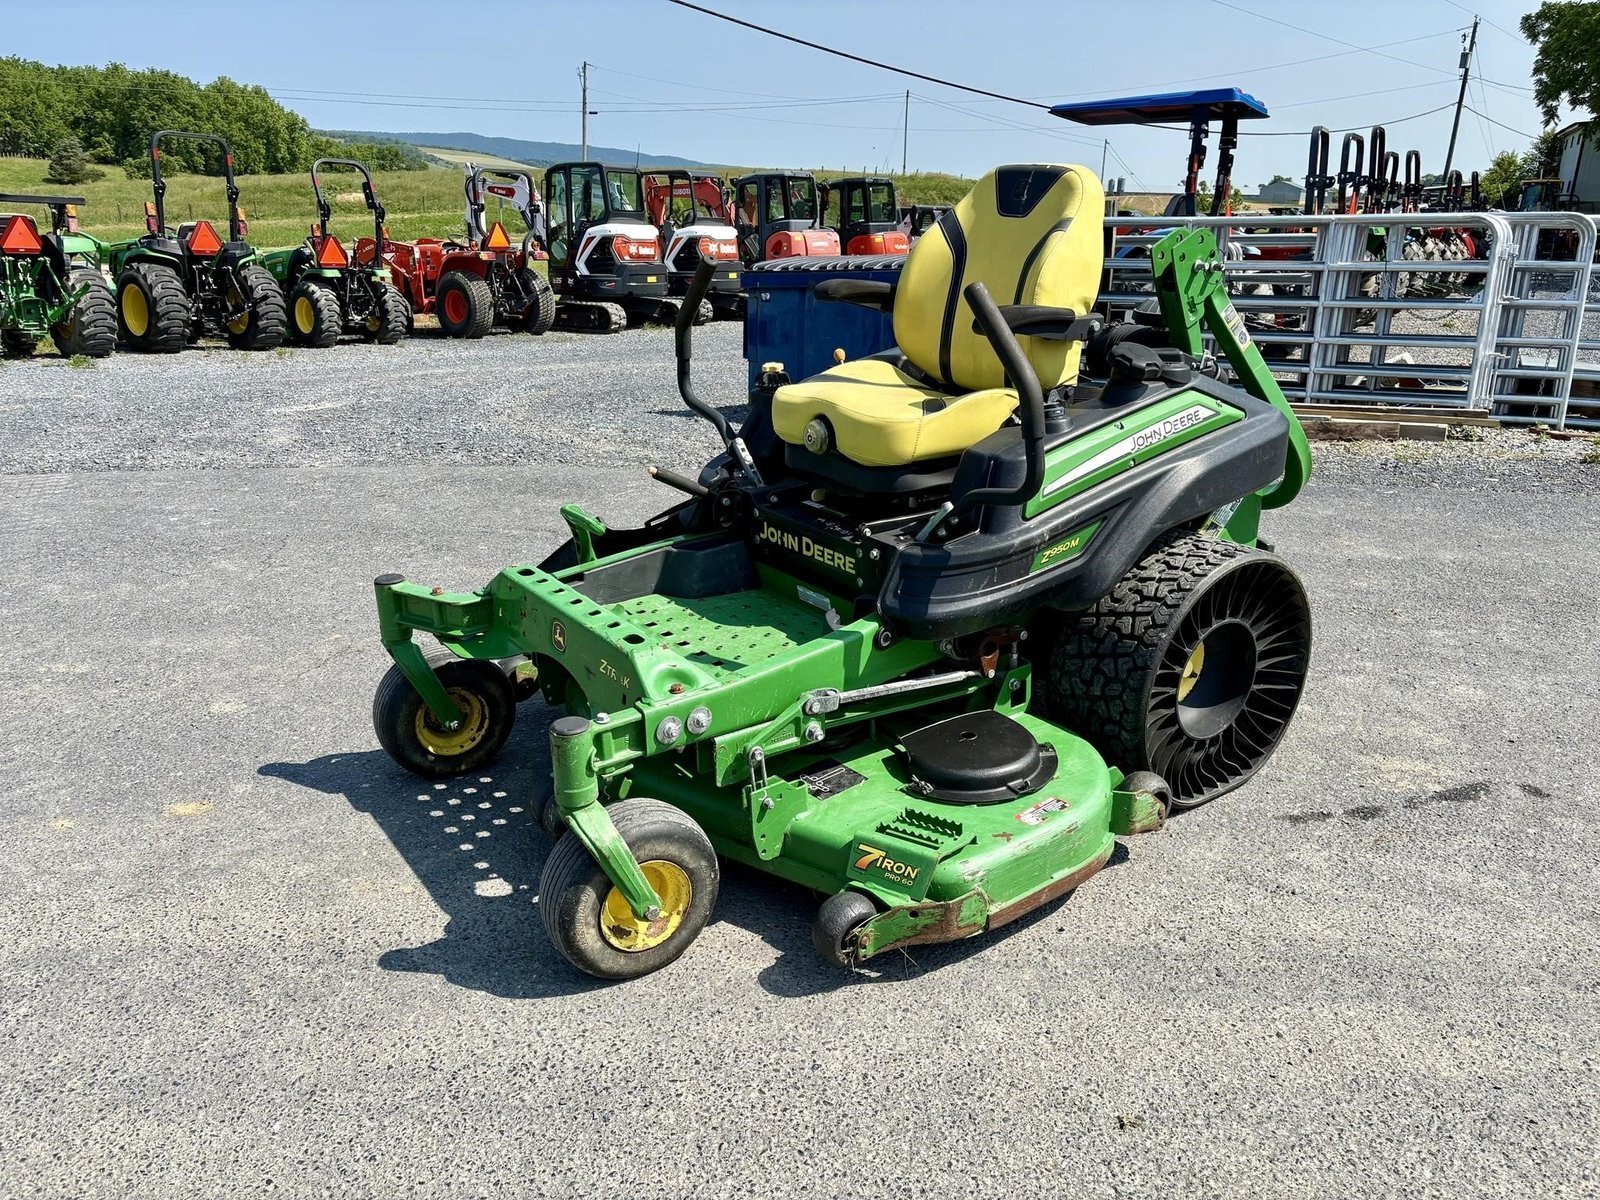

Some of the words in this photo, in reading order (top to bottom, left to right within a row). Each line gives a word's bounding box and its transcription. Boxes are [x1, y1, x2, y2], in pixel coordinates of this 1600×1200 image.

[1130, 427, 1162, 451] JOHN
[1163, 409, 1201, 435] DEERE
[760, 521, 799, 552] JOHN
[802, 536, 856, 575] DEERE
[1040, 537, 1080, 564] Z950M
[599, 658, 630, 689] ZTRK
[854, 843, 887, 870] 7
[884, 872, 901, 882] PRO
[901, 878, 914, 886] 60
